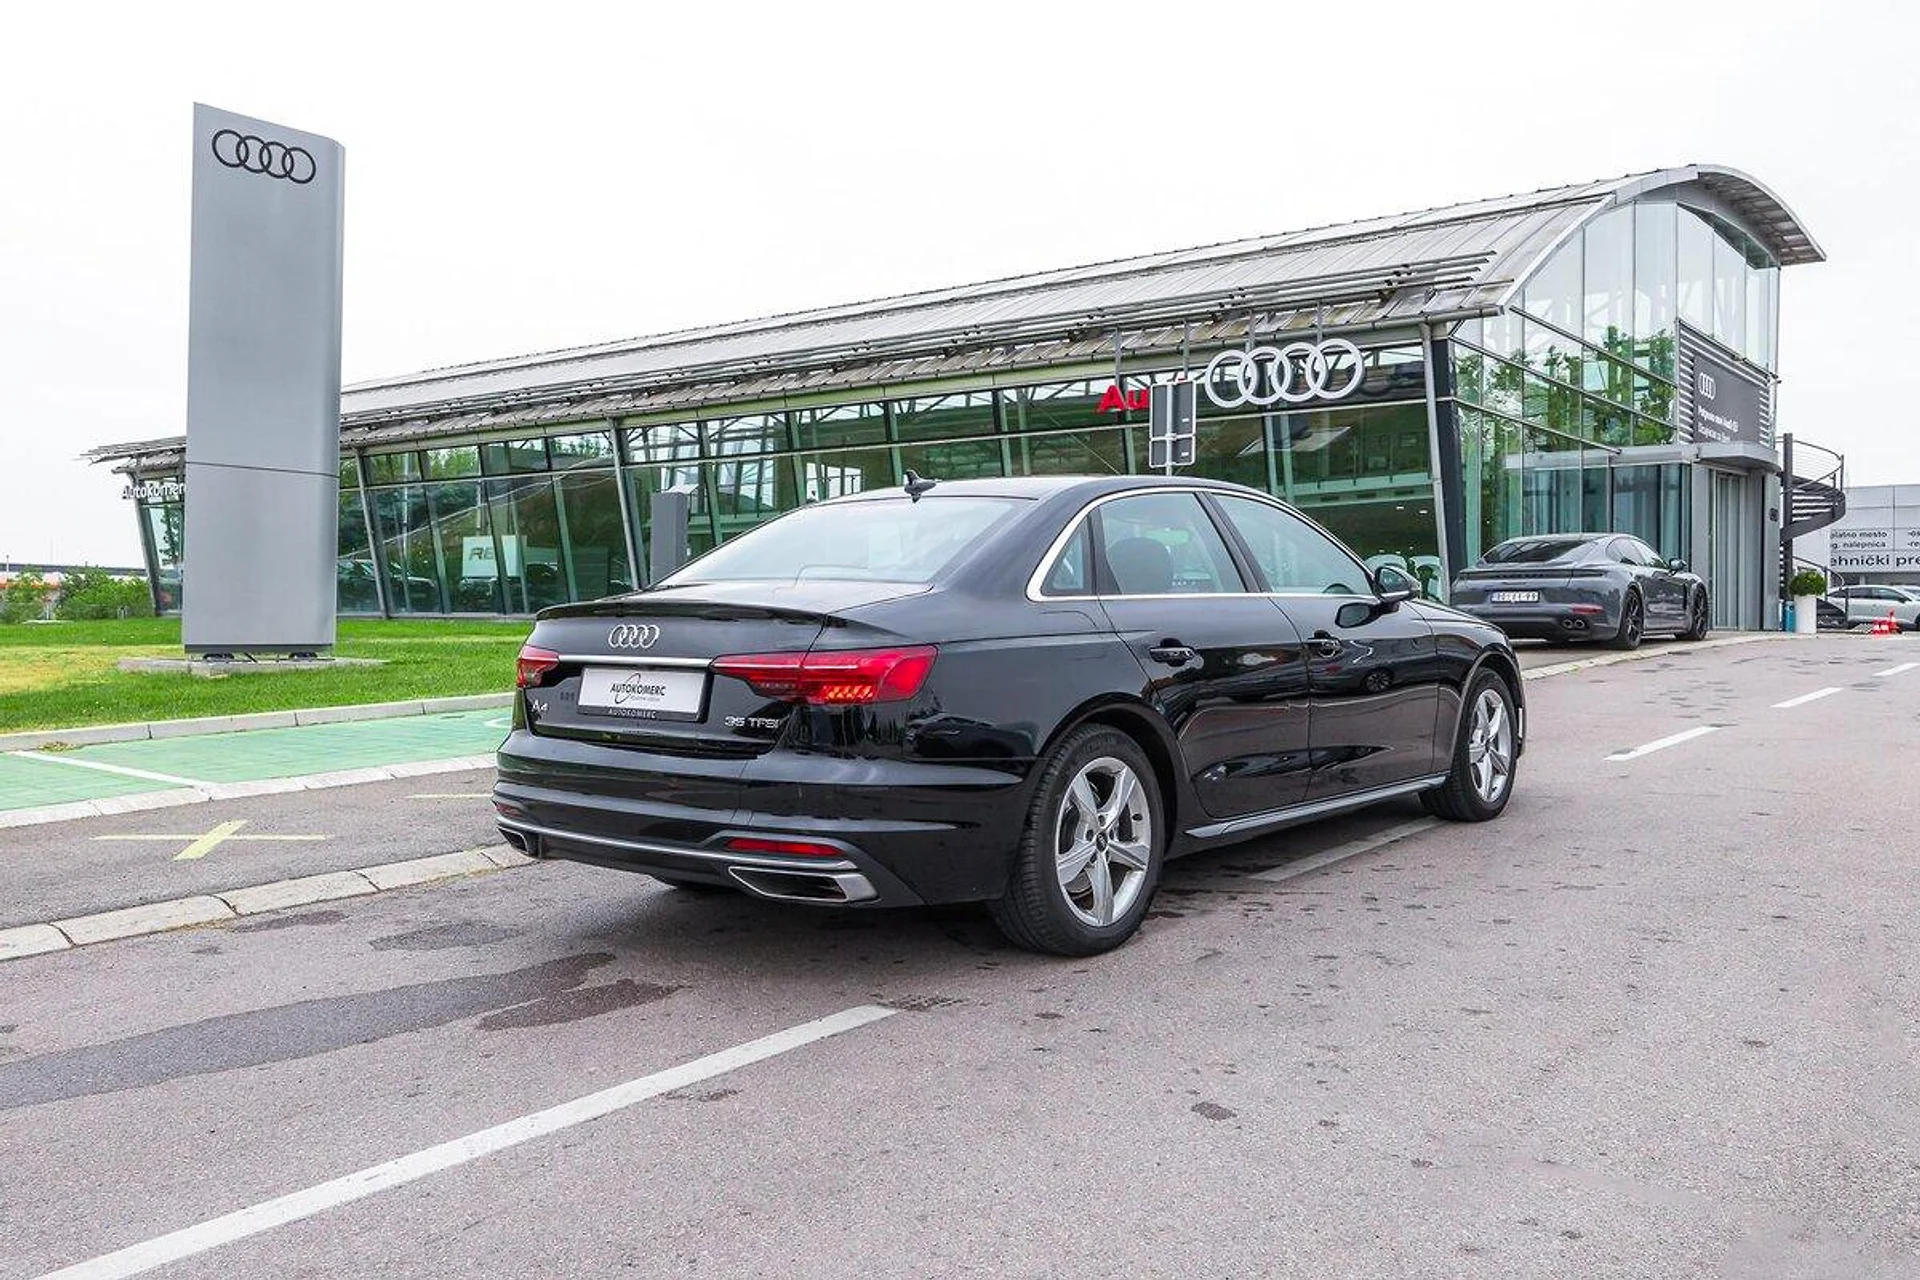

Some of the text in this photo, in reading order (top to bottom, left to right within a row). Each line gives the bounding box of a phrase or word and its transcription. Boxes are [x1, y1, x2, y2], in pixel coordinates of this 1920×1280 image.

[1096, 384, 1149, 414] Au
[122, 482, 185, 499] Autokomer
[1860, 531, 1888, 539] mesto
[1831, 554, 1890, 567] ehnički
[609, 683, 667, 696] AUTOKOMERC
[531, 699, 549, 712] A4
[724, 715, 779, 729] 35 TFSI
